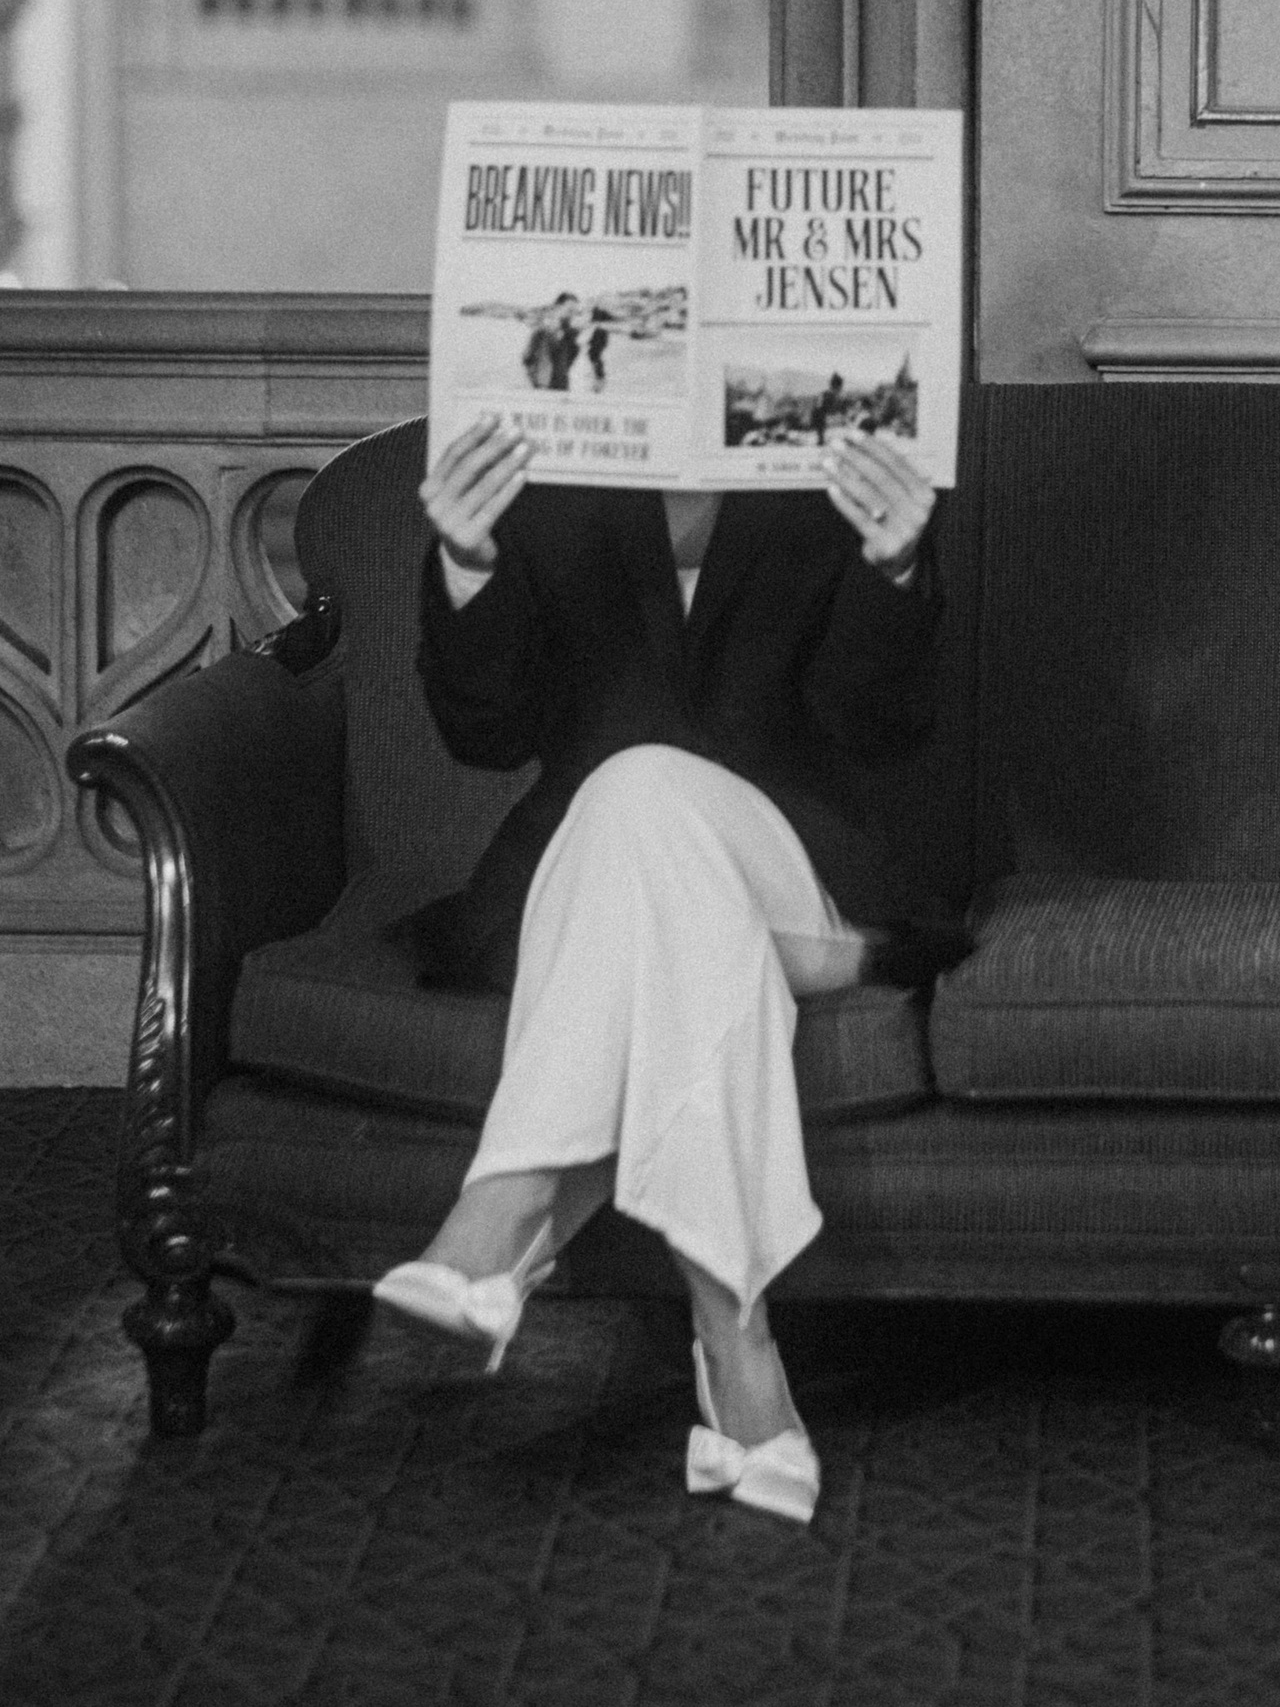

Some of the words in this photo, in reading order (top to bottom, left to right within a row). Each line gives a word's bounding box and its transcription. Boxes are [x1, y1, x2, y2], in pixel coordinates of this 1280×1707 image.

[465, 164, 596, 236] BREAKING
[604, 169, 692, 239] NEWS!!
[747, 167, 896, 213] FUTURE
[734, 216, 786, 261] MR
[803, 216, 829, 261] &
[845, 216, 923, 262] MRS
[755, 265, 899, 311] JENSEN
